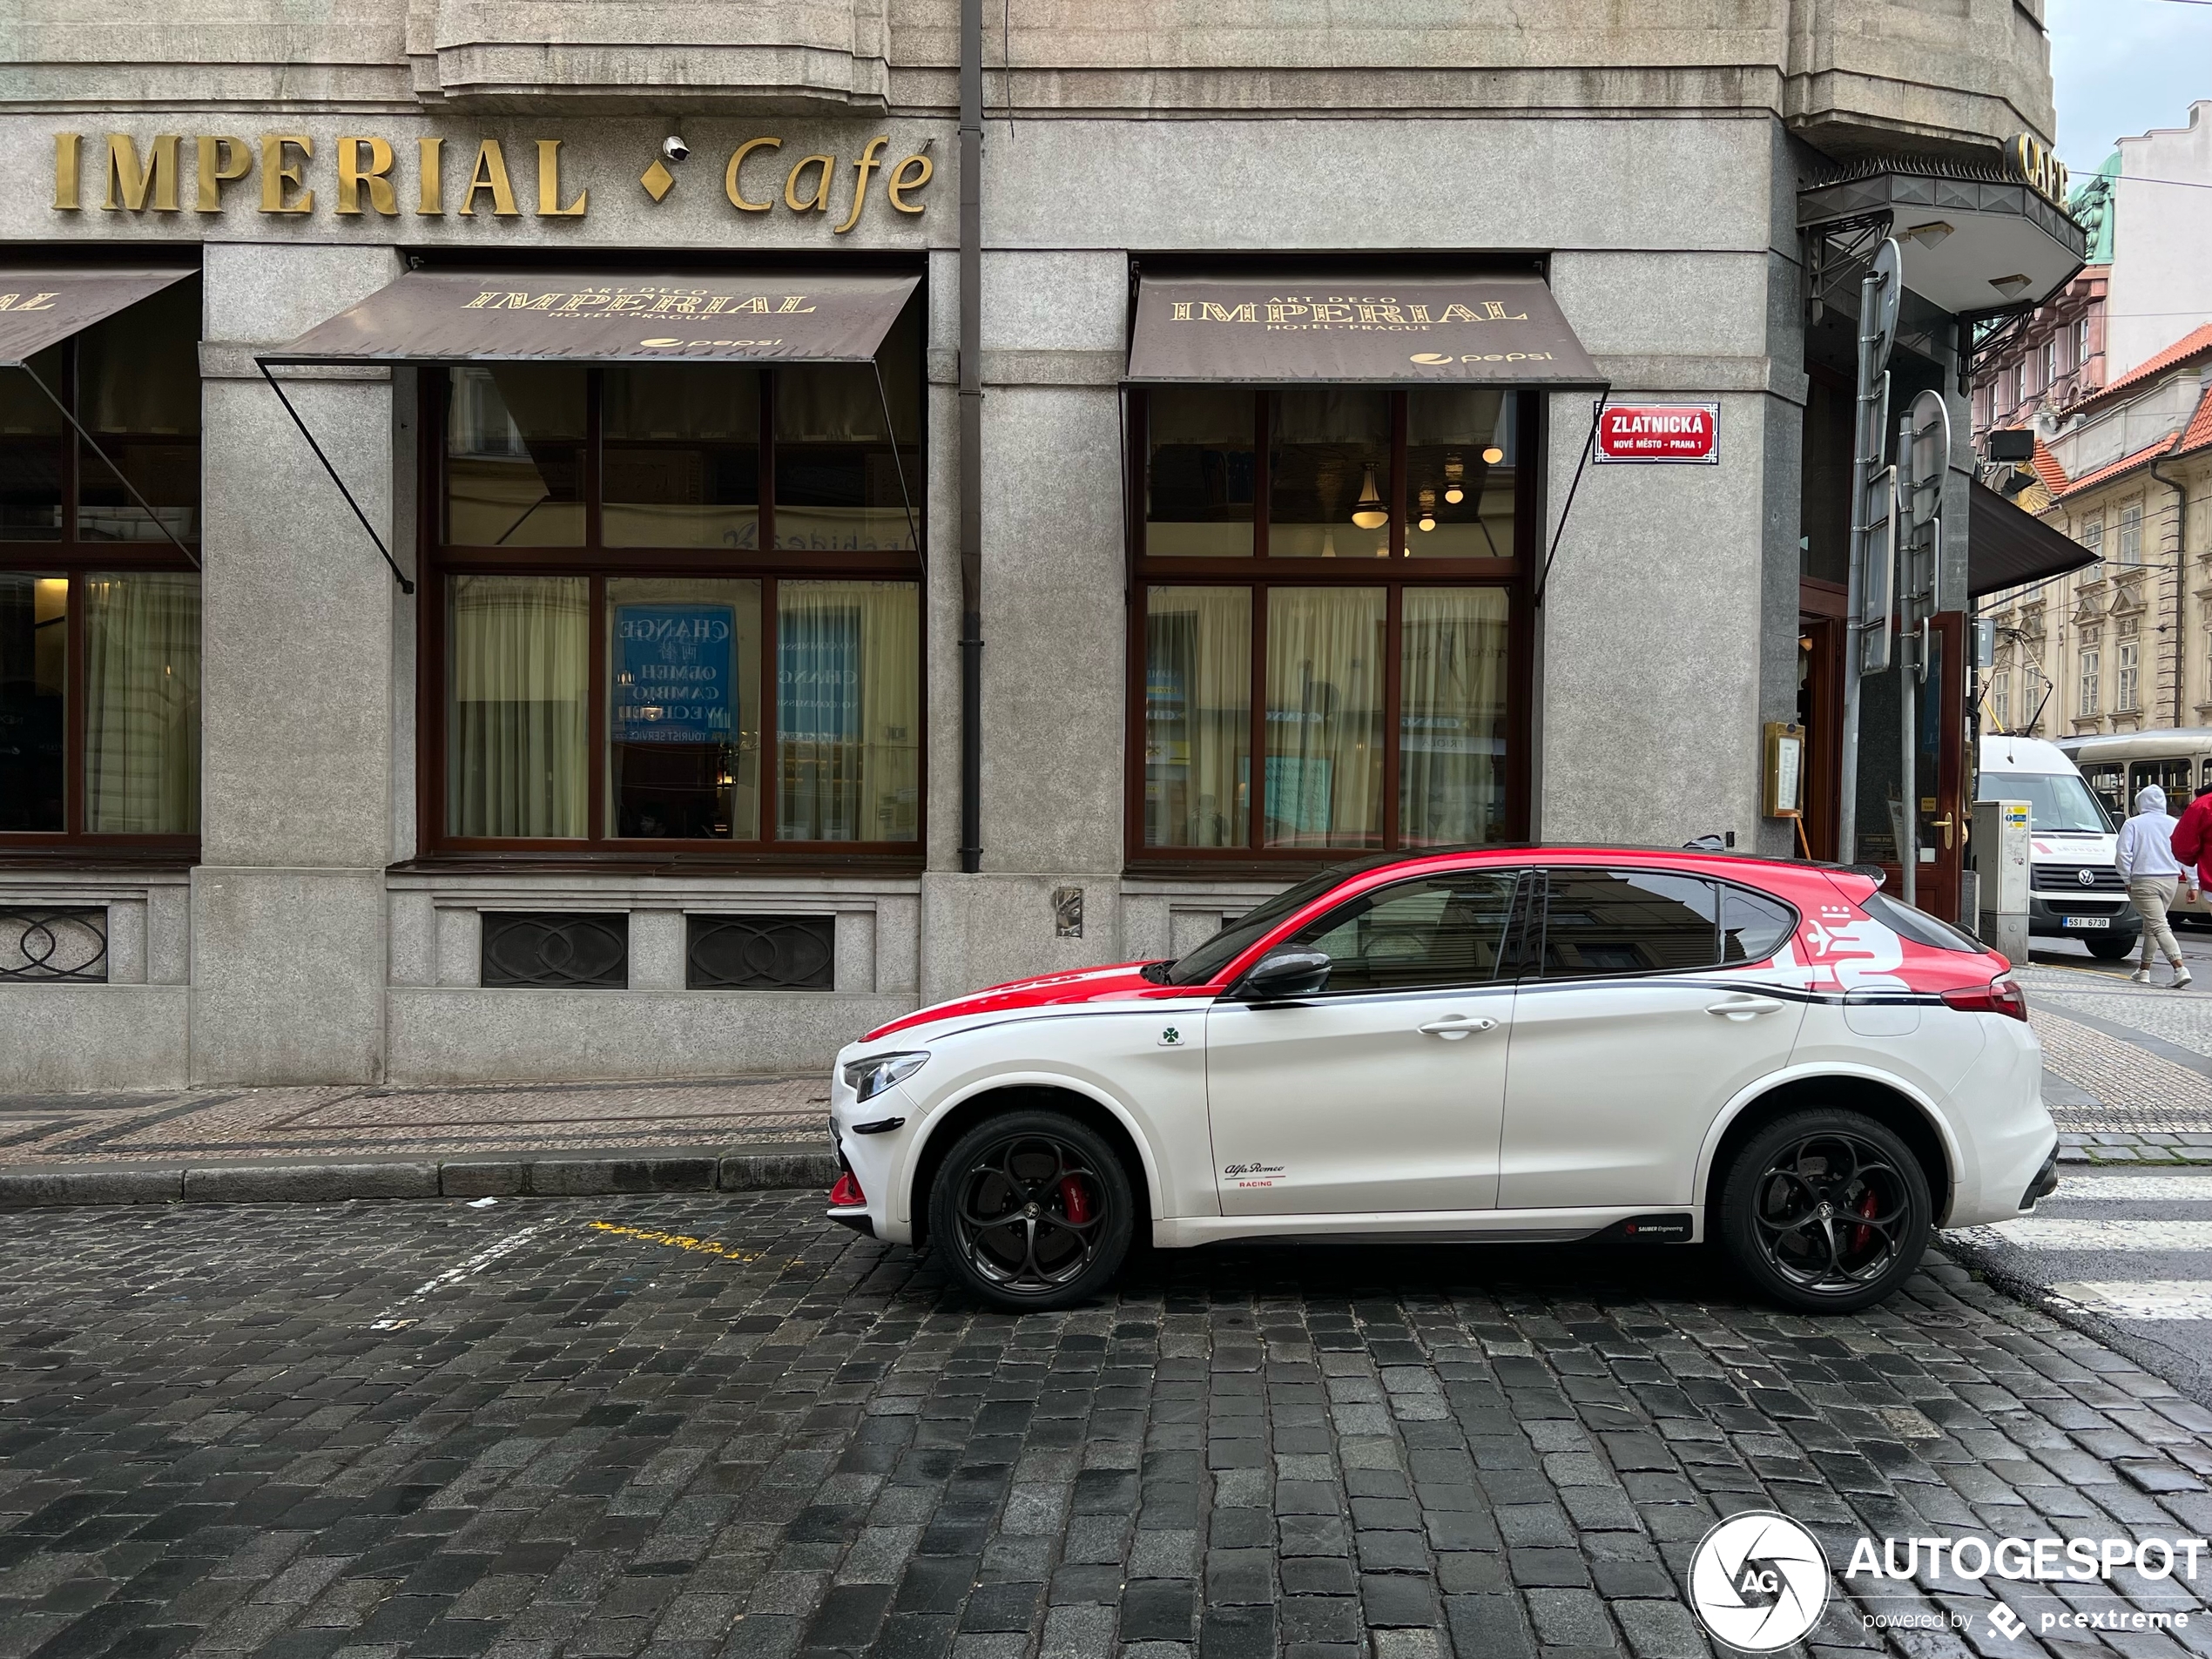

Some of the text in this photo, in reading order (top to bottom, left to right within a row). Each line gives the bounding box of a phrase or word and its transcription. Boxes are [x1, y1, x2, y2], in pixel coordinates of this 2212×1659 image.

[51, 132, 934, 235] IMPERIAL Café
[639, 287, 708, 295] DECO
[460, 292, 818, 314] IMPERIAL
[629, 312, 712, 320] PRAGUE
[1169, 301, 1528, 323] IMPERIAL
[687, 338, 783, 347] pepsi
[1460, 351, 1554, 364] pepsi
[1611, 413, 1704, 434] ZLATNICKÁ
[1613, 438, 1634, 449] NOVÉ
[1636, 438, 1662, 449] MĚSTO
[1669, 440, 1696, 449] PRAHA
[1697, 441, 1702, 449] 1
[2068, 918, 2082, 927] 5SI
[1224, 1163, 1285, 1177] Alfa Romeo
